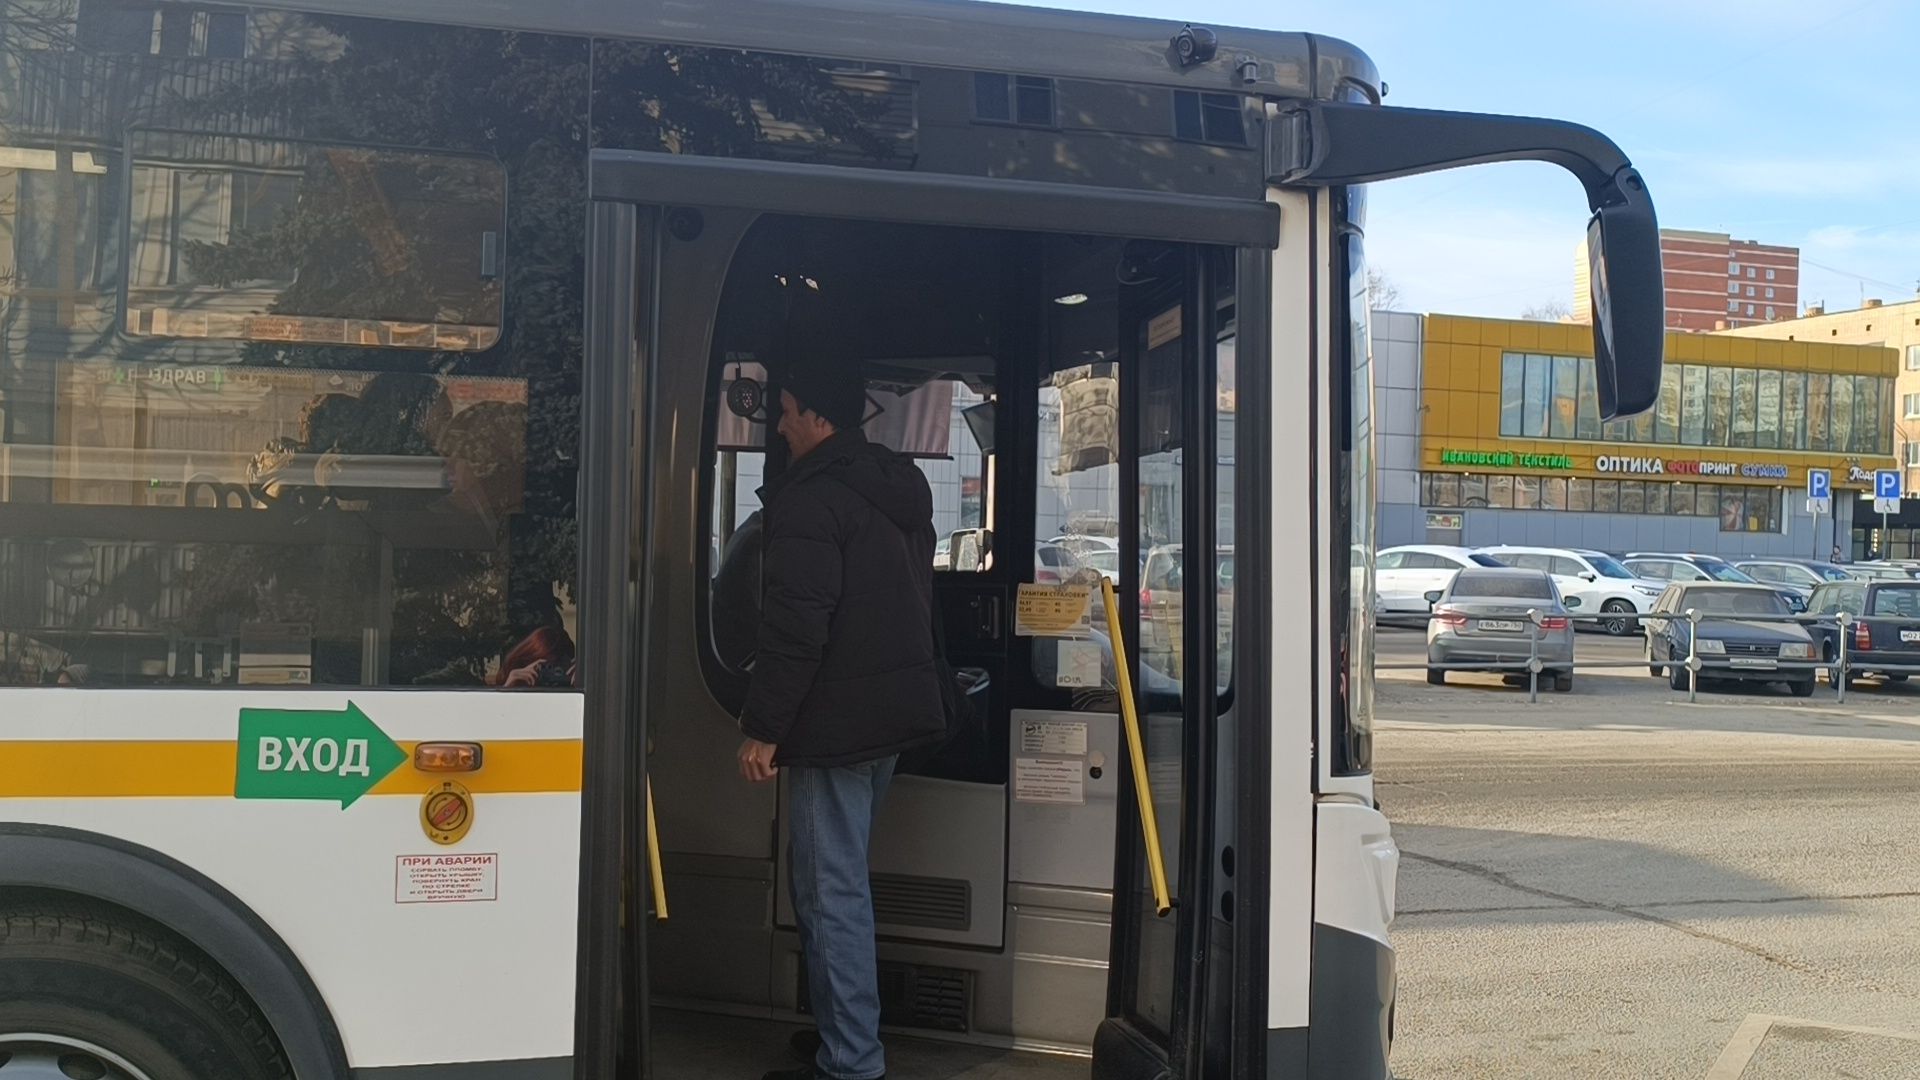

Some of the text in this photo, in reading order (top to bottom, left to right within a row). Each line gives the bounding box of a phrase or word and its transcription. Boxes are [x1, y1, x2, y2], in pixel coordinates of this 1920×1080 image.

[1442, 448, 1574, 469] ИВАНОВСКИЙ ТЕКСТИЛЬ
[1596, 455, 1664, 474] ОПТИКА
[1881, 472, 1896, 496] P
[257, 736, 370, 777] ВХОД
[402, 856, 492, 866] ПРИ АВАРИИ
